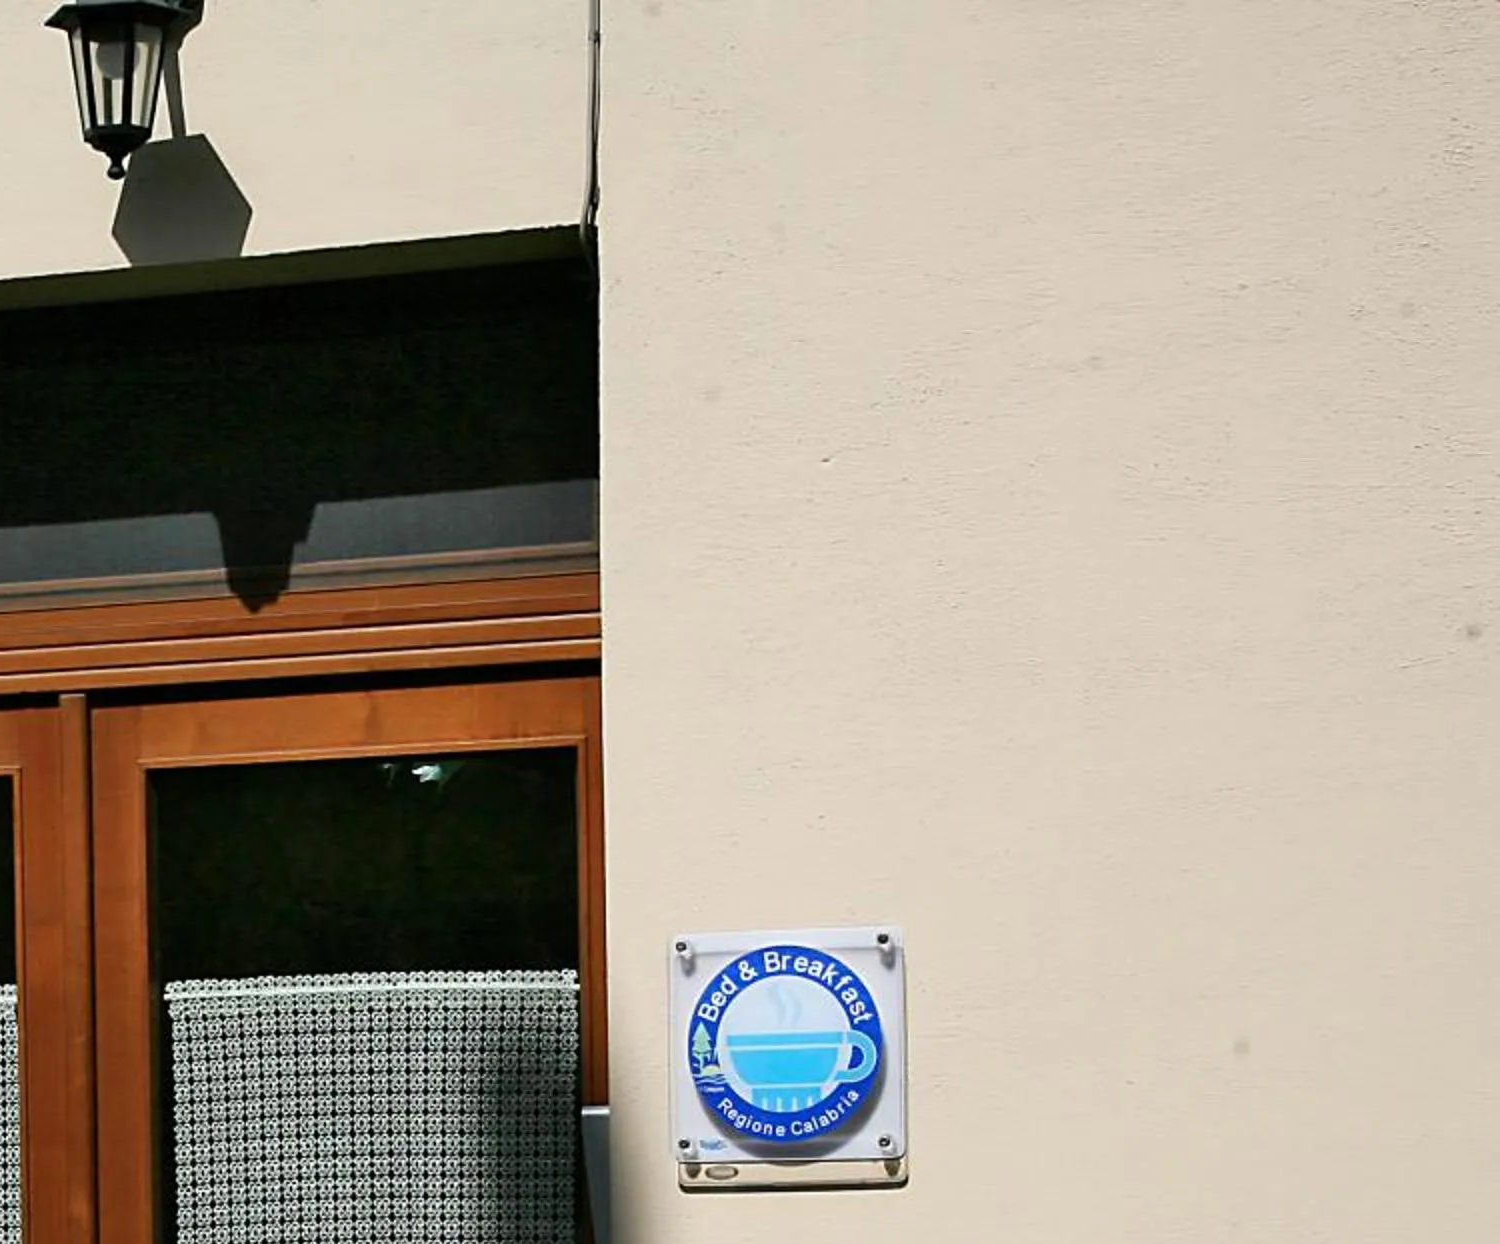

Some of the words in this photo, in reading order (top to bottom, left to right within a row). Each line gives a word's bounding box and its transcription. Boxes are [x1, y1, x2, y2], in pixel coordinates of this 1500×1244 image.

[697, 977, 739, 1022] Bed
[738, 960, 758, 981] &
[764, 951, 874, 1024] Breakfast
[718, 1097, 786, 1137] Regione
[791, 1089, 859, 1136] Calabria
